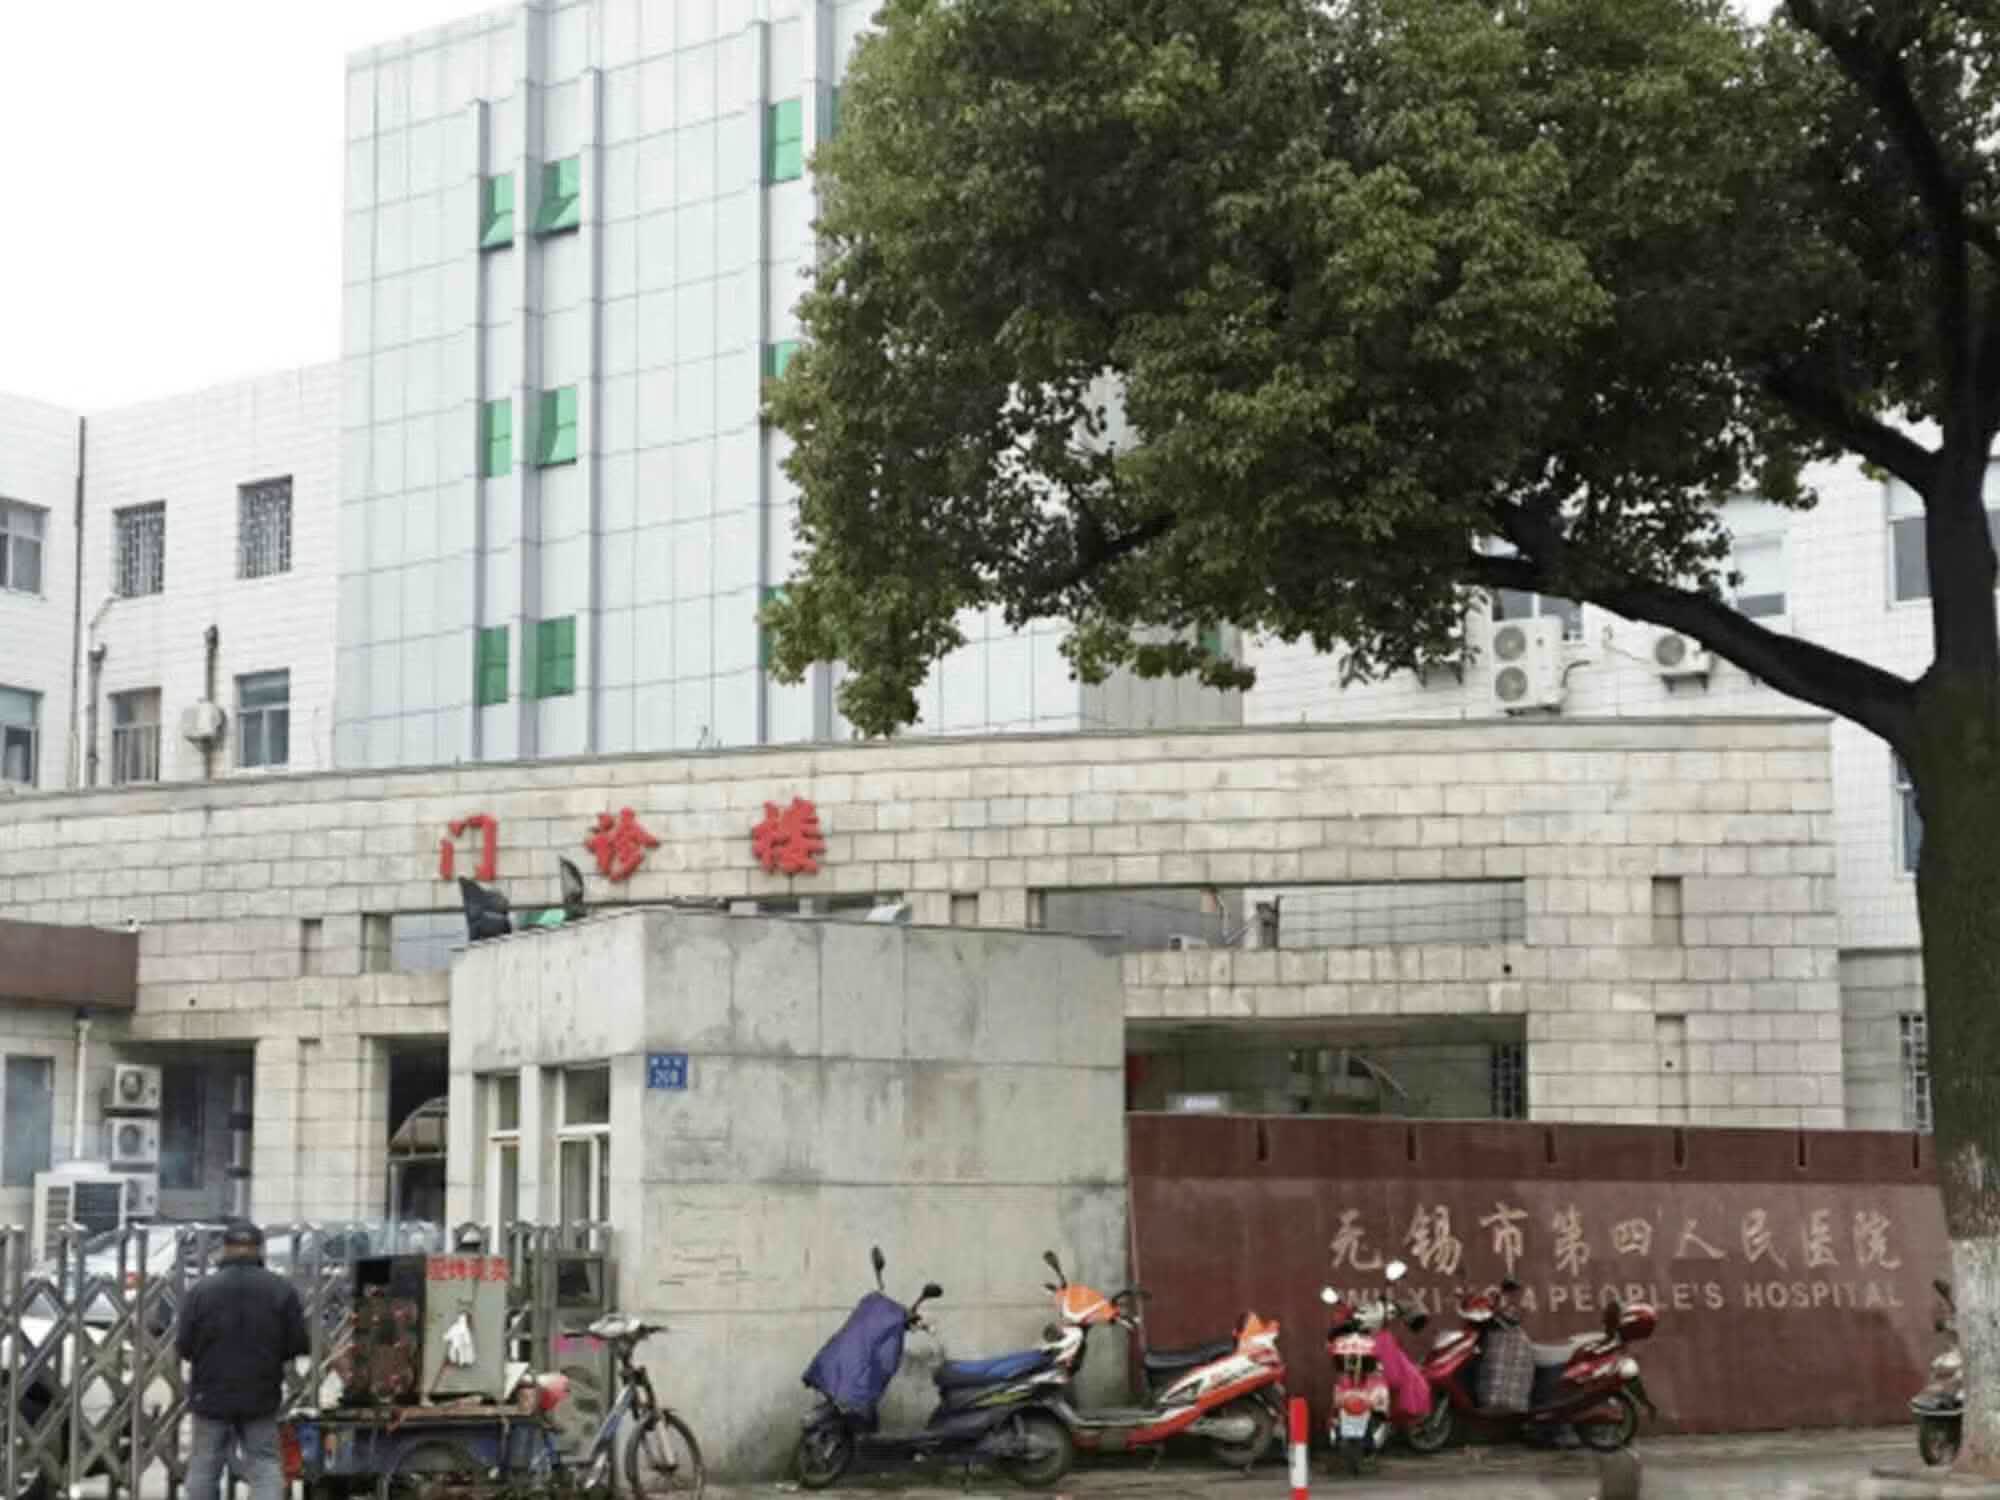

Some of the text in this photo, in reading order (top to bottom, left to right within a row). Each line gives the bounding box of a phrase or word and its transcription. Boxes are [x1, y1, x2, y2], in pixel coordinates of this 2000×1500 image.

[440, 796, 826, 883] 门诊楼
[1329, 1202, 1902, 1277] 无锡市第四人民医院
[1551, 1282, 1725, 1313] PEOPLE'S
[1742, 1281, 1904, 1311] HOSPITAL
